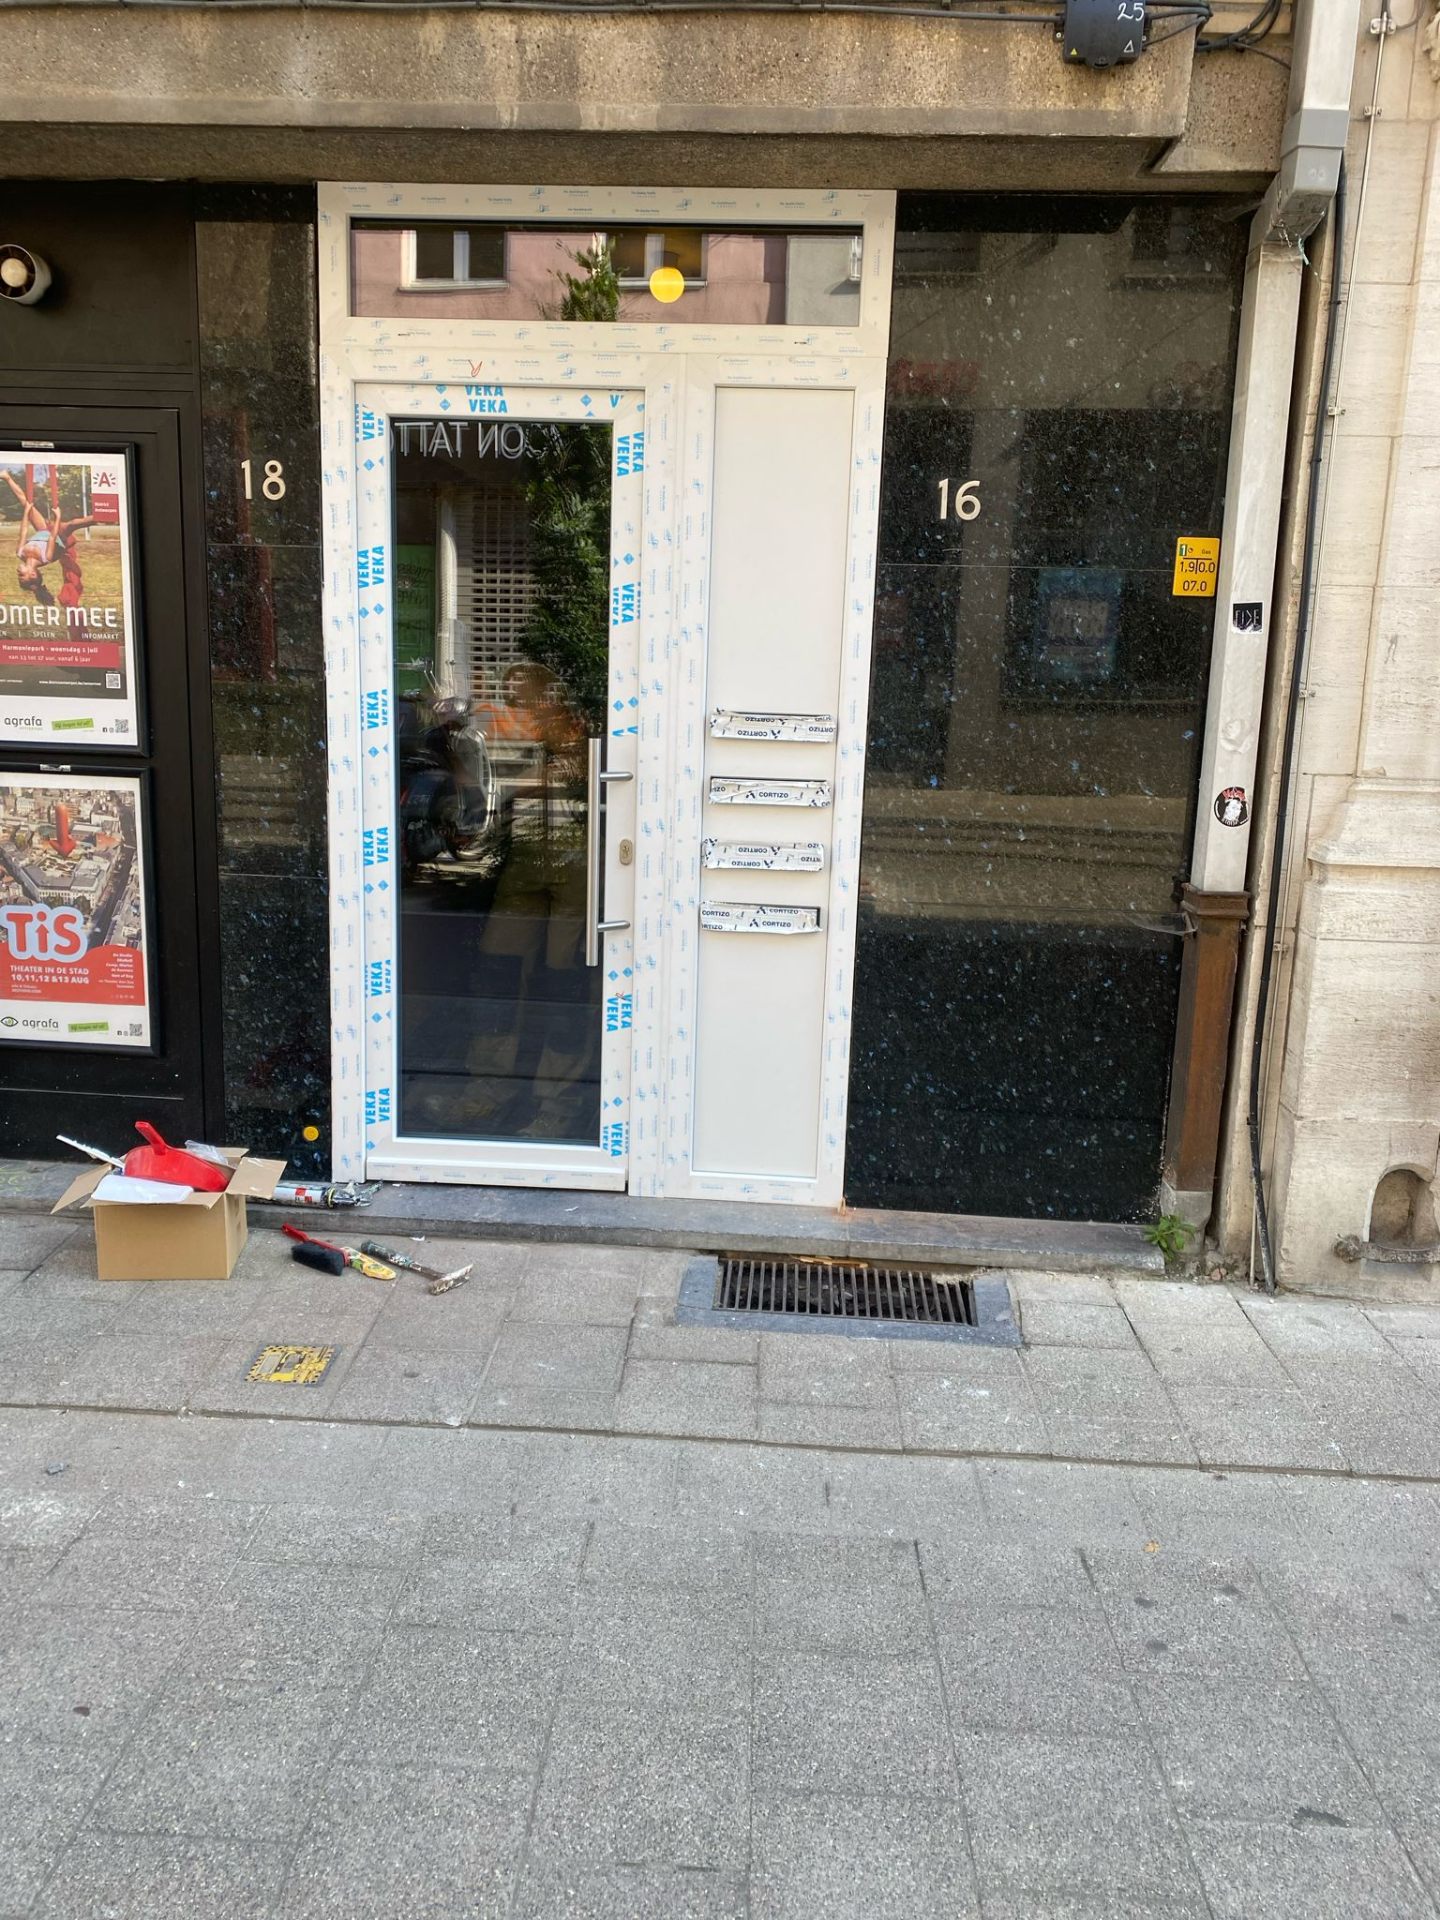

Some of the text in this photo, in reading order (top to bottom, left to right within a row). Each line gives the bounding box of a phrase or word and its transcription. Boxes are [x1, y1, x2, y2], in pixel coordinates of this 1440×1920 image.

[1116, 2, 1145, 22] 25
[464, 385, 505, 397] VEKA
[468, 399, 508, 413] VEKA
[362, 402, 374, 441] VEK
[617, 435, 630, 477] VEKA
[632, 431, 645, 473] VEKA
[240, 459, 287, 501] 18
[938, 478, 982, 521] 16
[358, 549, 369, 589] VEKA
[372, 546, 385, 586] VEKA
[622, 583, 635, 624] VEKA
[1182, 580, 1207, 592] 07.0
[4, 716, 42, 728] agrafa
[367, 691, 379, 730] VEKA
[737, 729, 768, 737] CORTIZO
[758, 791, 789, 799] CORTIZO
[363, 830, 374, 867] VEKA
[376, 827, 389, 863] VEKA
[737, 846, 768, 854] CORTIZO
[701, 909, 731, 917] CORTIZO
[761, 920, 792, 928] CORTIZO
[10, 965, 89, 976] THEATER IN DE STAD
[70, 976, 90, 985] AUG
[371, 961, 383, 996] VEKA
[22, 1018, 59, 1029] agrafa
[607, 997, 619, 1033] VEKA
[620, 994, 632, 1029] VEKA
[365, 1091, 376, 1125] VEKA
[379, 1087, 391, 1122] VEKA
[611, 1122, 624, 1157] VEKA
